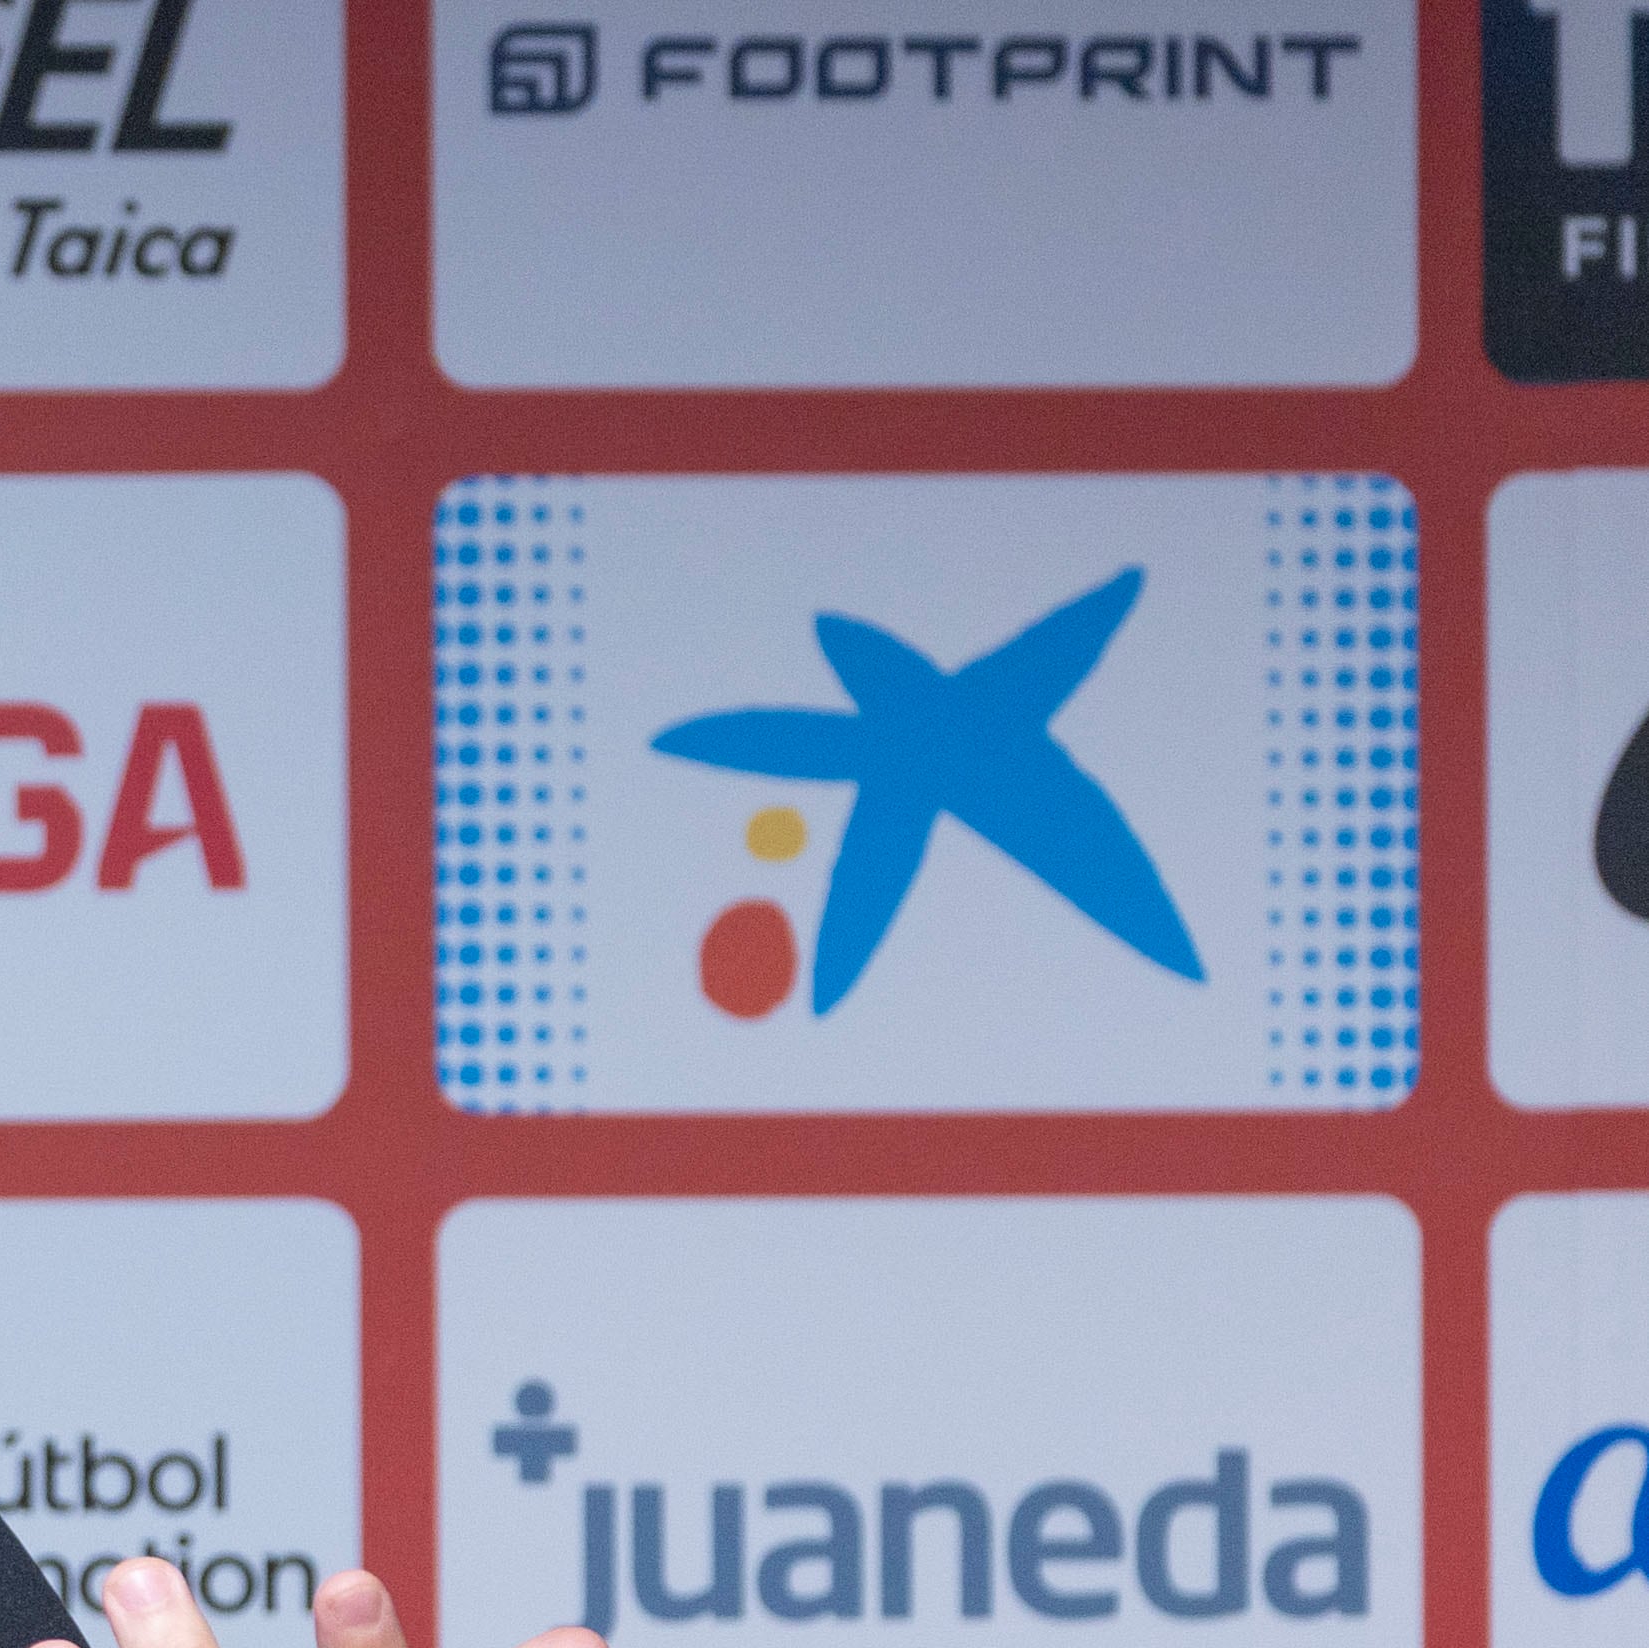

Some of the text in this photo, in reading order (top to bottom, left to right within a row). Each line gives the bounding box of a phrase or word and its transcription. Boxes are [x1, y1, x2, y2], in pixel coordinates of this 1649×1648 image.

[640, 35, 1363, 102] FOOTPRINT
[10, 198, 236, 280] Taica
[579, 1447, 1371, 1640] juaneda
